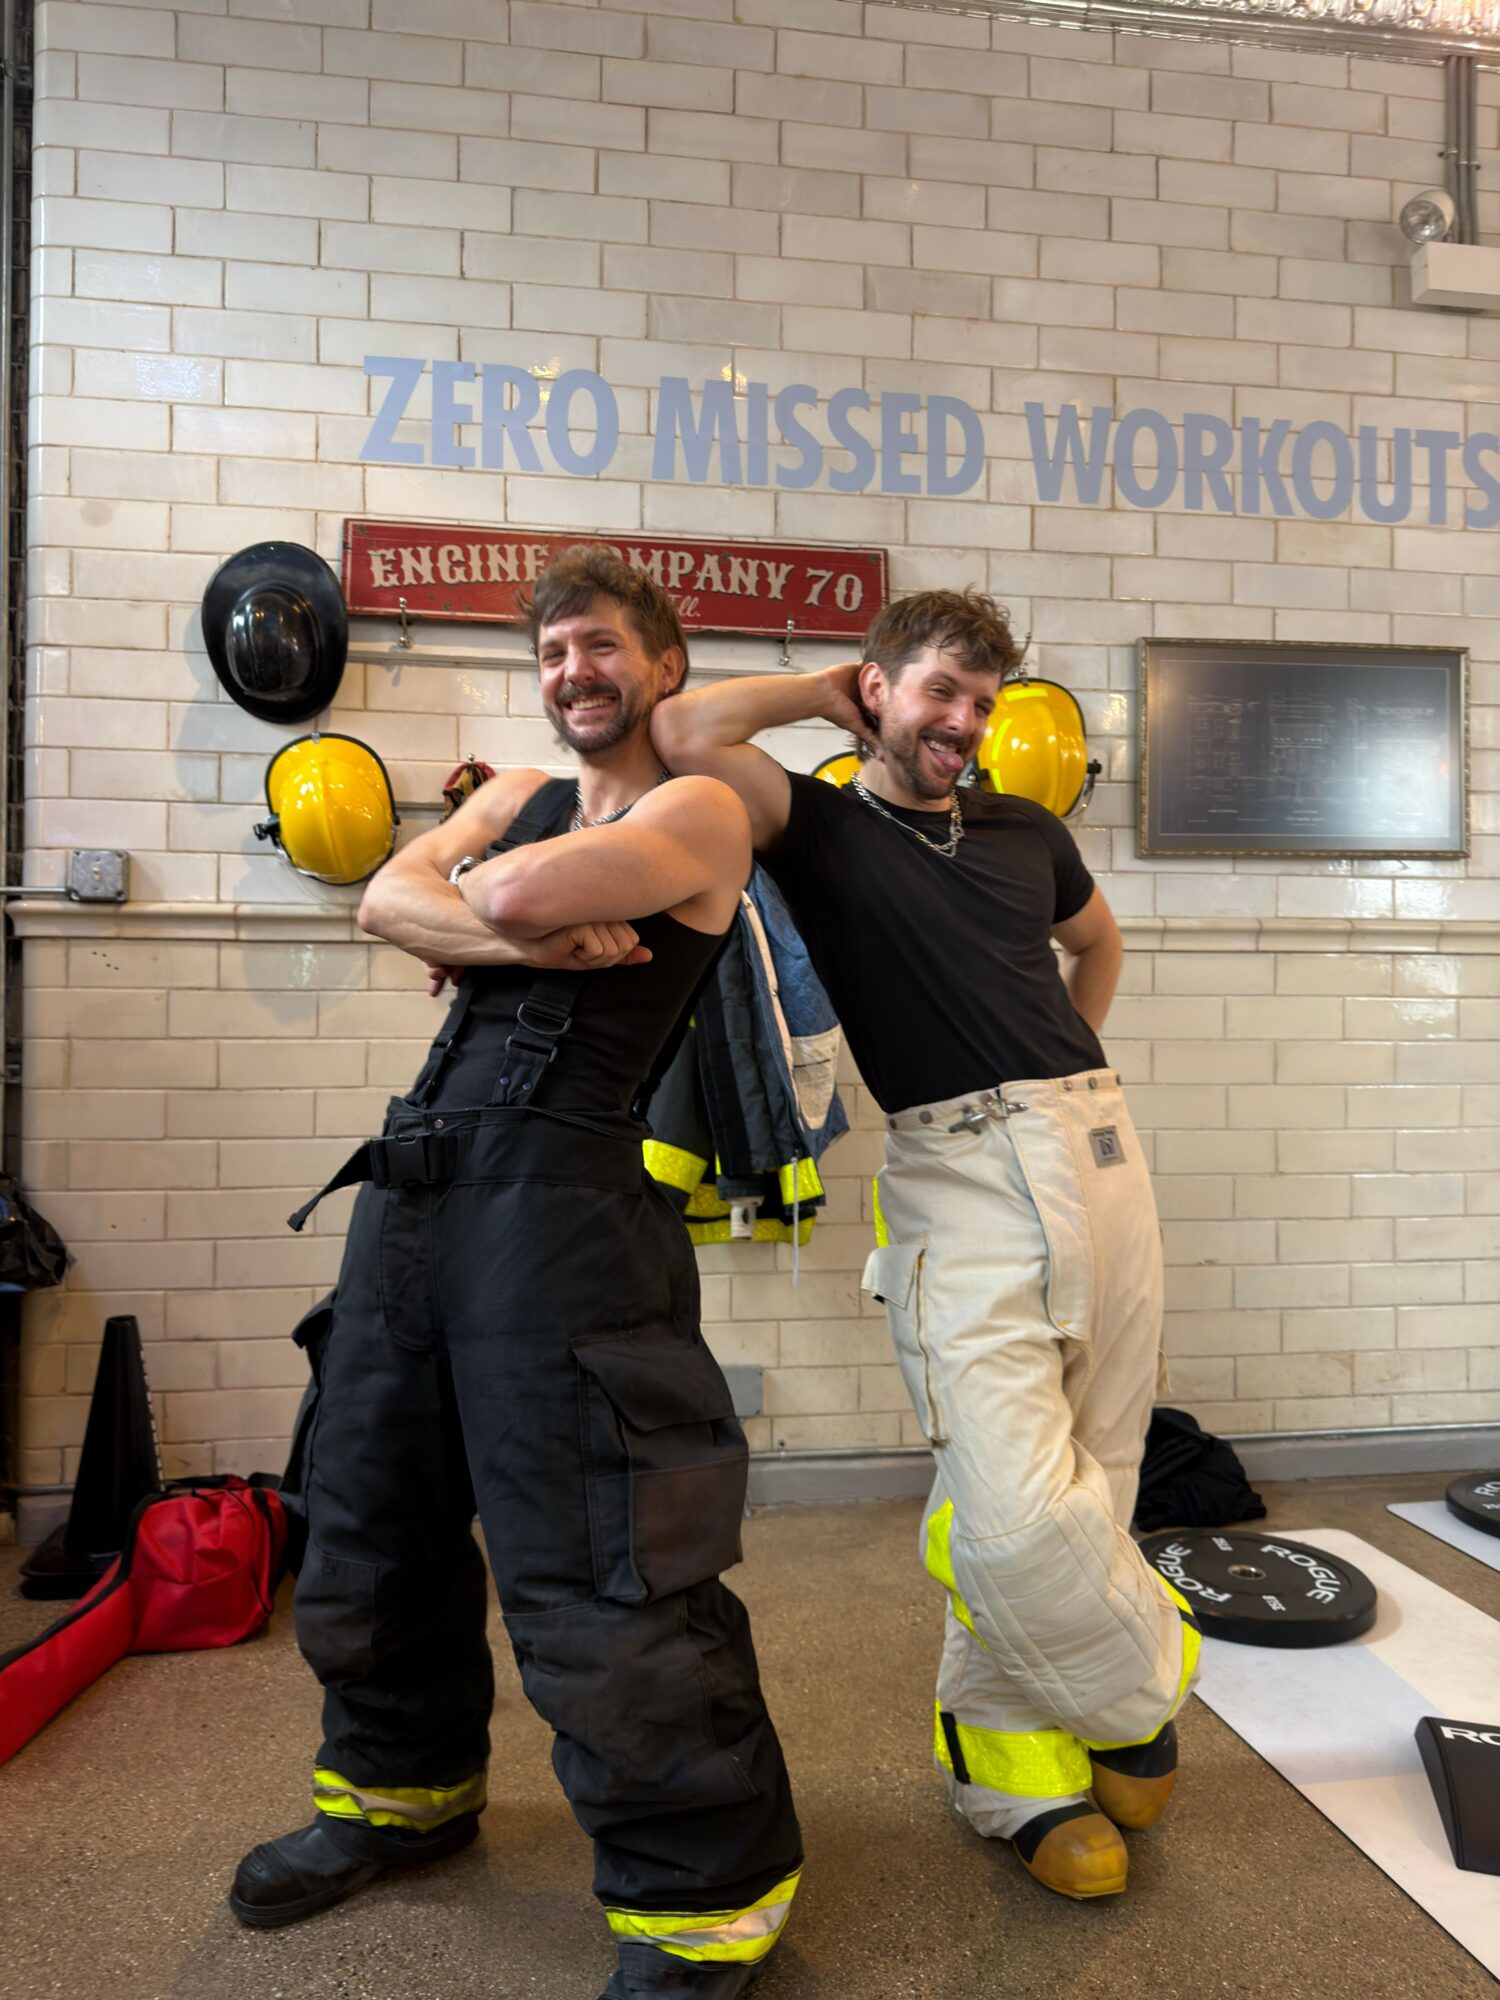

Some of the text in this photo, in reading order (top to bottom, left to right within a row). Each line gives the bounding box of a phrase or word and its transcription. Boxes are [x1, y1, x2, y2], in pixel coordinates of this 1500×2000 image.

[359, 355, 1500, 529] ZERO MISSED WORKOUTS
[367, 543, 864, 612] ENGINE MPANY 70
[1155, 1542, 1232, 1602] ROGUE
[1260, 1544, 1341, 1604] ROGUE
